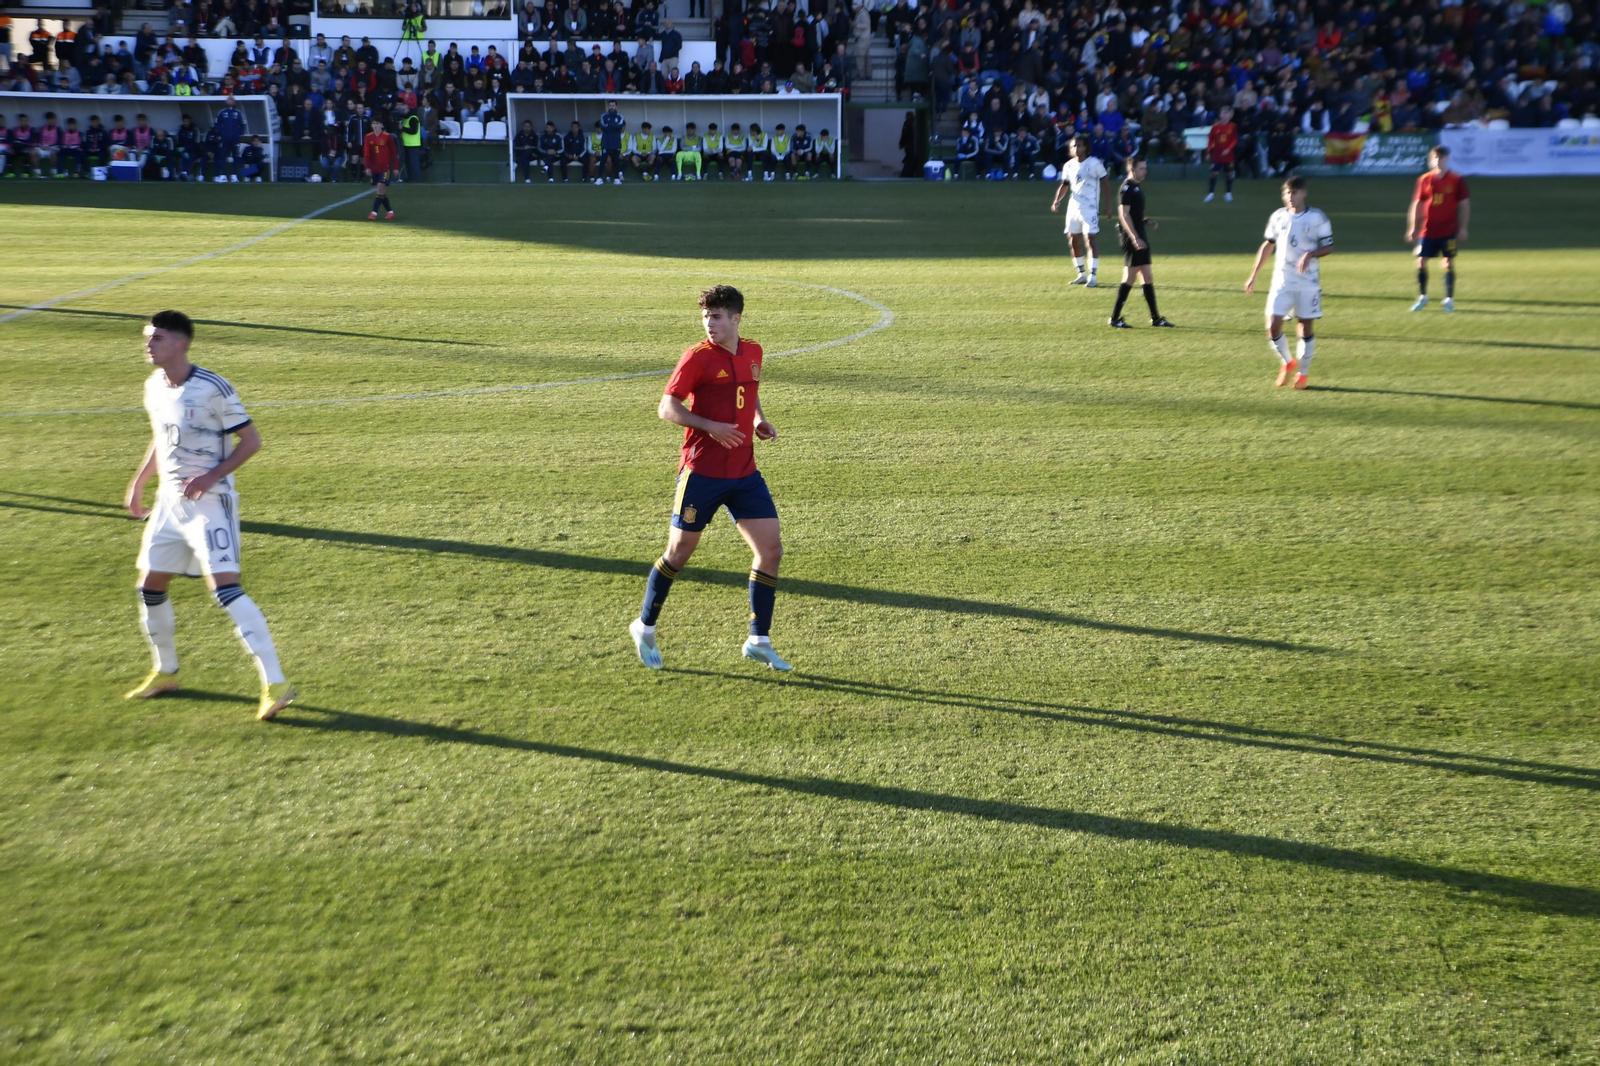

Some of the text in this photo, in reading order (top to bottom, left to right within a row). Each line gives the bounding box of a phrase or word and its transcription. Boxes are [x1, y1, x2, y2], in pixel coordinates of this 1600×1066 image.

[1294, 137, 1322, 147] OTEL
[1291, 235, 1298, 247] 6
[1312, 294, 1318, 306] 6
[736, 386, 745, 409] 6
[164, 423, 181, 446] 10
[206, 527, 230, 551] 10
